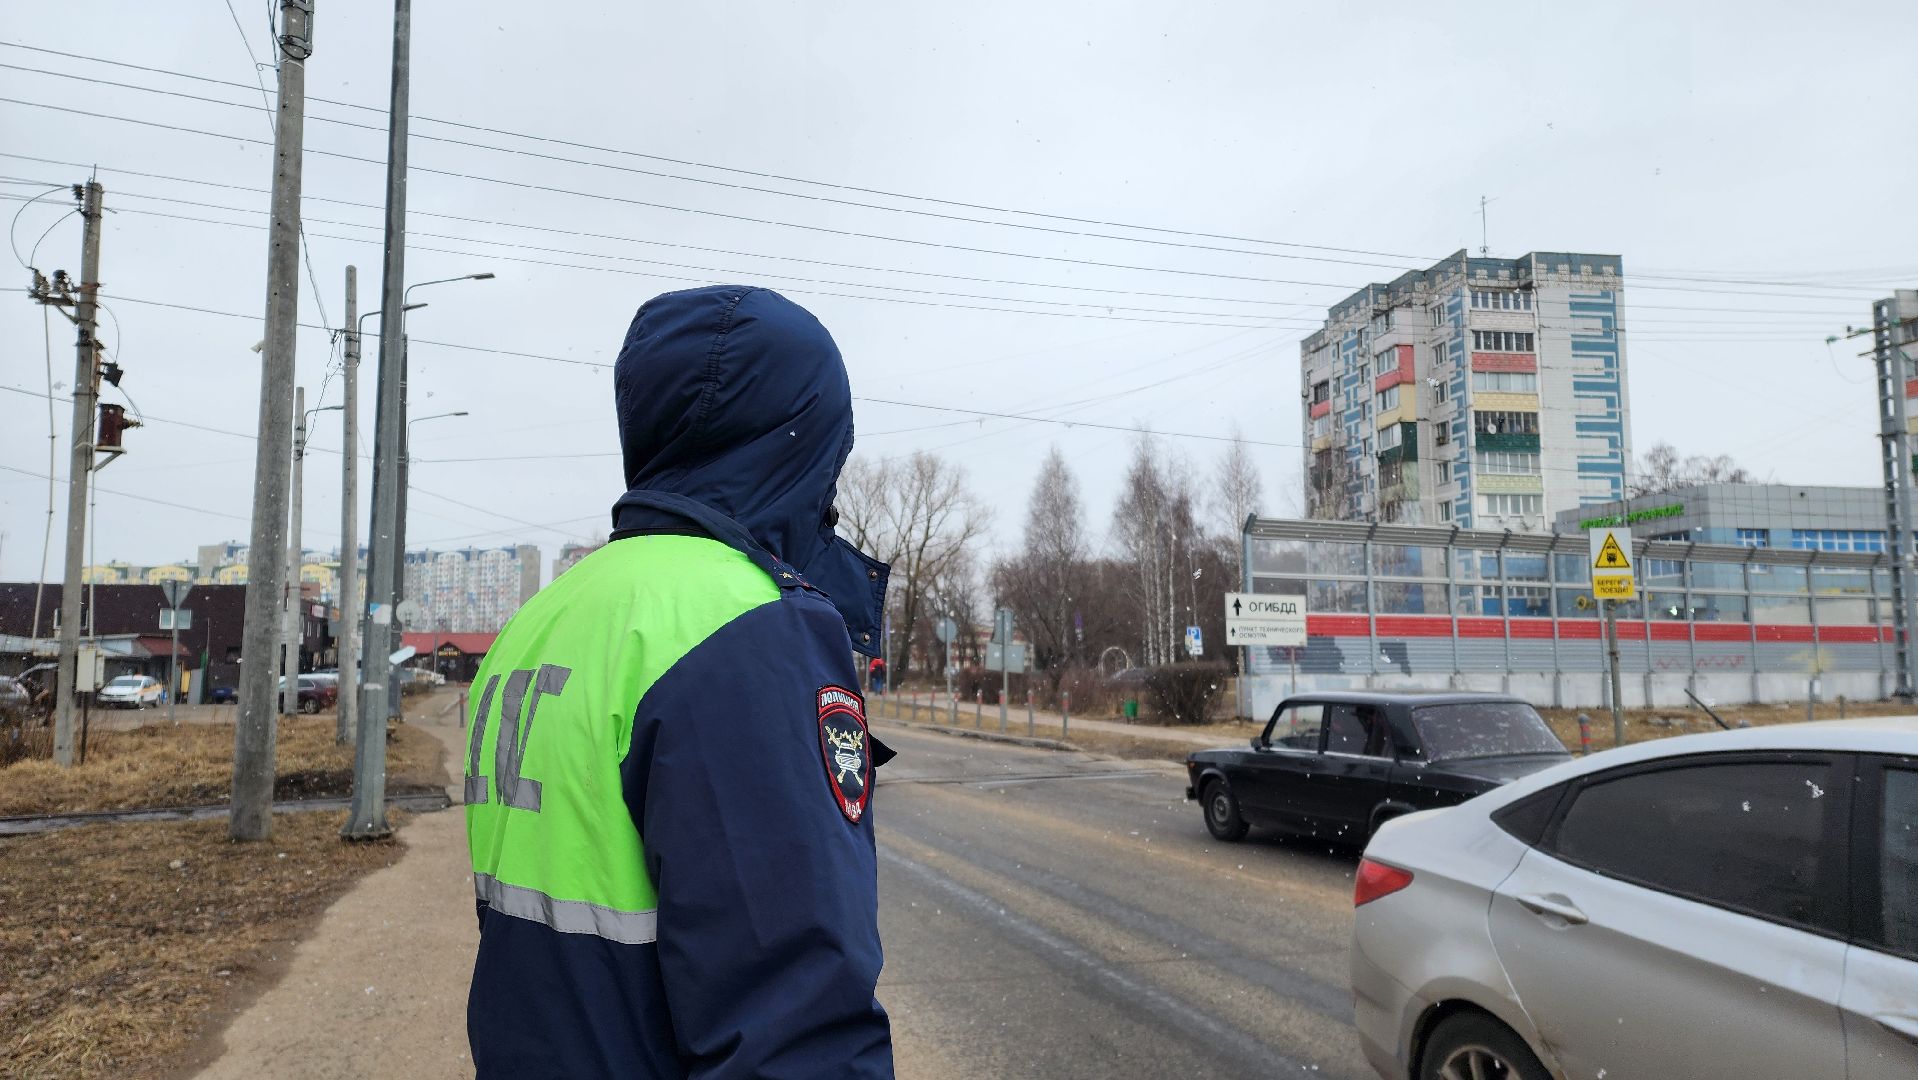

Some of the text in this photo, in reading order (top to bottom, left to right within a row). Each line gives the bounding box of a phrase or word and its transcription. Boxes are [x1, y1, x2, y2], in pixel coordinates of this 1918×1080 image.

[1249, 601, 1297, 615] ОГИБДД
[1238, 625, 1304, 634] ПУНКТ ТЕХНИЧЕСКОГО
[820, 690, 860, 712] ПОЛИЦИЯ
[844, 798, 862, 819] МВД
